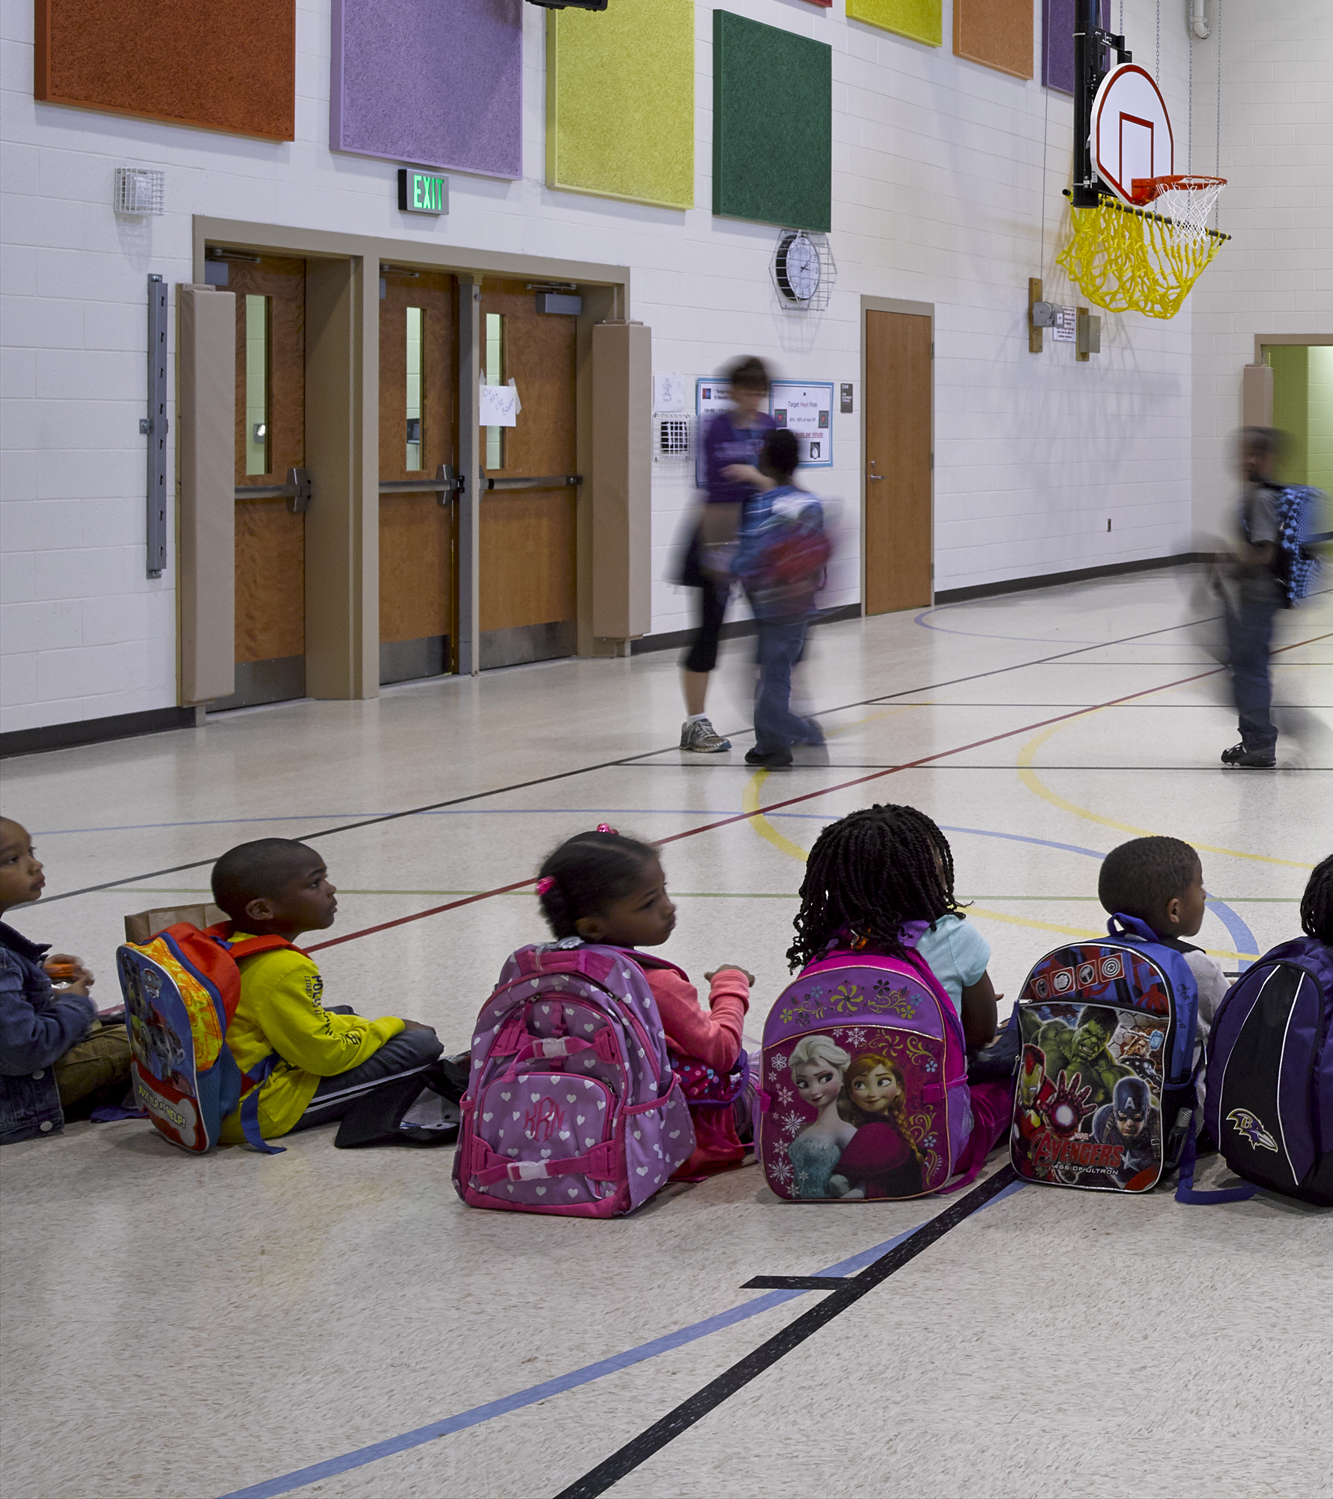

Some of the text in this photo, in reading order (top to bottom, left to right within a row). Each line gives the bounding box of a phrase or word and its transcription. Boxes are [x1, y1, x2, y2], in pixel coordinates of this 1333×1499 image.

[413, 174, 444, 211] EXIT
[1124, 1097, 1136, 1110] A
[166, 1105, 186, 1129] HELP!
[1031, 1130, 1125, 1168] AVENGERS
[1085, 1167, 1119, 1176] ULTRON
